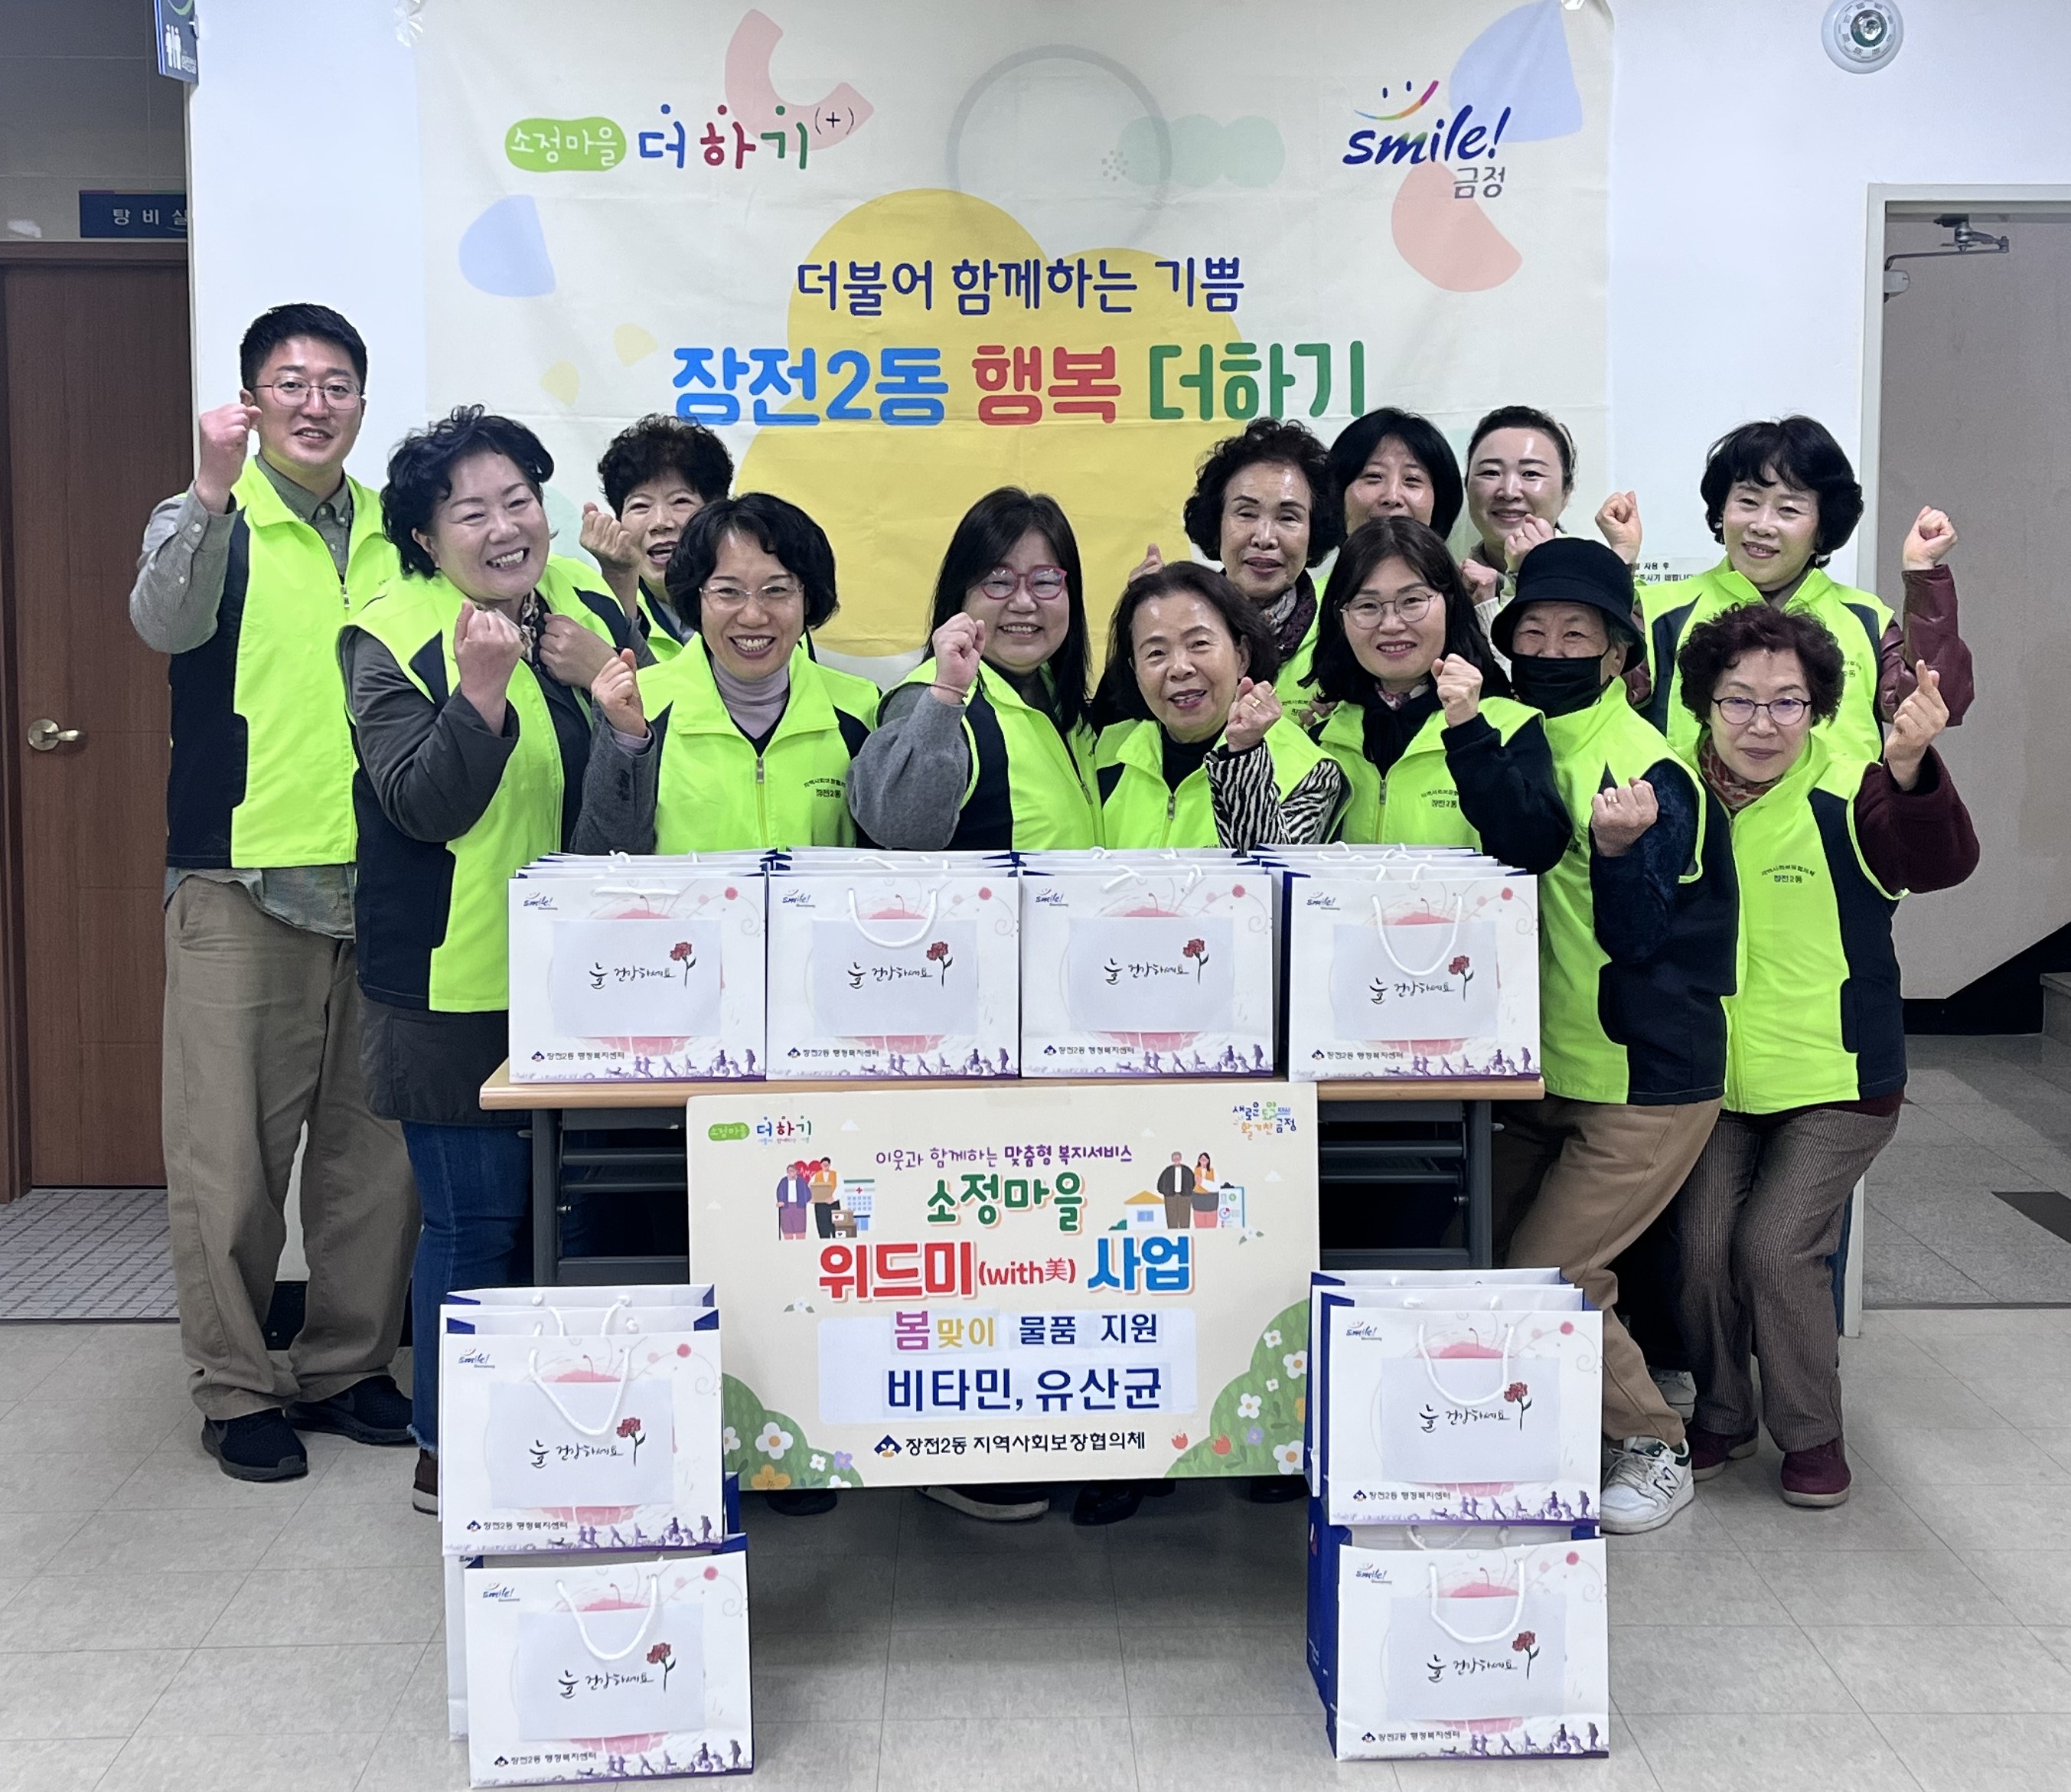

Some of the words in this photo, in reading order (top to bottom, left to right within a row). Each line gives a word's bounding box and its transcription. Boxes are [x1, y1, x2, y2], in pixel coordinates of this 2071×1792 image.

[510, 126, 617, 166] 소정마을
[1343, 106, 1512, 165] smile!
[1453, 167, 1505, 199] 금정
[797, 260, 934, 316] 더불어
[952, 256, 1137, 315] 함께하는
[1155, 255, 1247, 314] 기쁨
[673, 346, 949, 426] 장전2동
[973, 346, 1120, 424] 행복
[1149, 340, 1366, 422] 더하기
[589, 963, 606, 989] 늘
[614, 966, 675, 981] 건강하세요
[848, 962, 866, 989] 늘
[872, 966, 932, 981] 건강하세요
[1104, 958, 1121, 985] 늘
[1128, 962, 1189, 978] 건강하세요
[1370, 978, 1387, 1004] 늘
[1394, 981, 1454, 997] 건강하세요
[757, 1116, 811, 1137] 더하기
[1276, 1118, 1296, 1133] 금정
[876, 1150, 923, 1170] 이웃과
[930, 1147, 997, 1168] 함께하는
[1005, 1144, 1052, 1167] 맞춤형
[1059, 1145, 1132, 1165] 복지서비스
[928, 1173, 1081, 1231] 소정마을
[1088, 1237, 1189, 1290] 사업
[1019, 1317, 1075, 1344] 물품
[1101, 1314, 1156, 1343] 지원
[1036, 1369, 1161, 1411] 유산균
[1420, 1405, 1438, 1433] 늘
[1446, 1408, 1509, 1425] 건강하세요
[530, 1440, 549, 1468] 늘
[556, 1444, 622, 1461] 건강하세요
[906, 1437, 967, 1455] 장전2동
[974, 1432, 1144, 1453] 지역사회보장협의체
[1427, 1655, 1446, 1683] 늘
[1453, 1658, 1516, 1675] 건강하세요
[559, 1670, 578, 1699] 늘
[585, 1672, 654, 1690] 건강하세요
